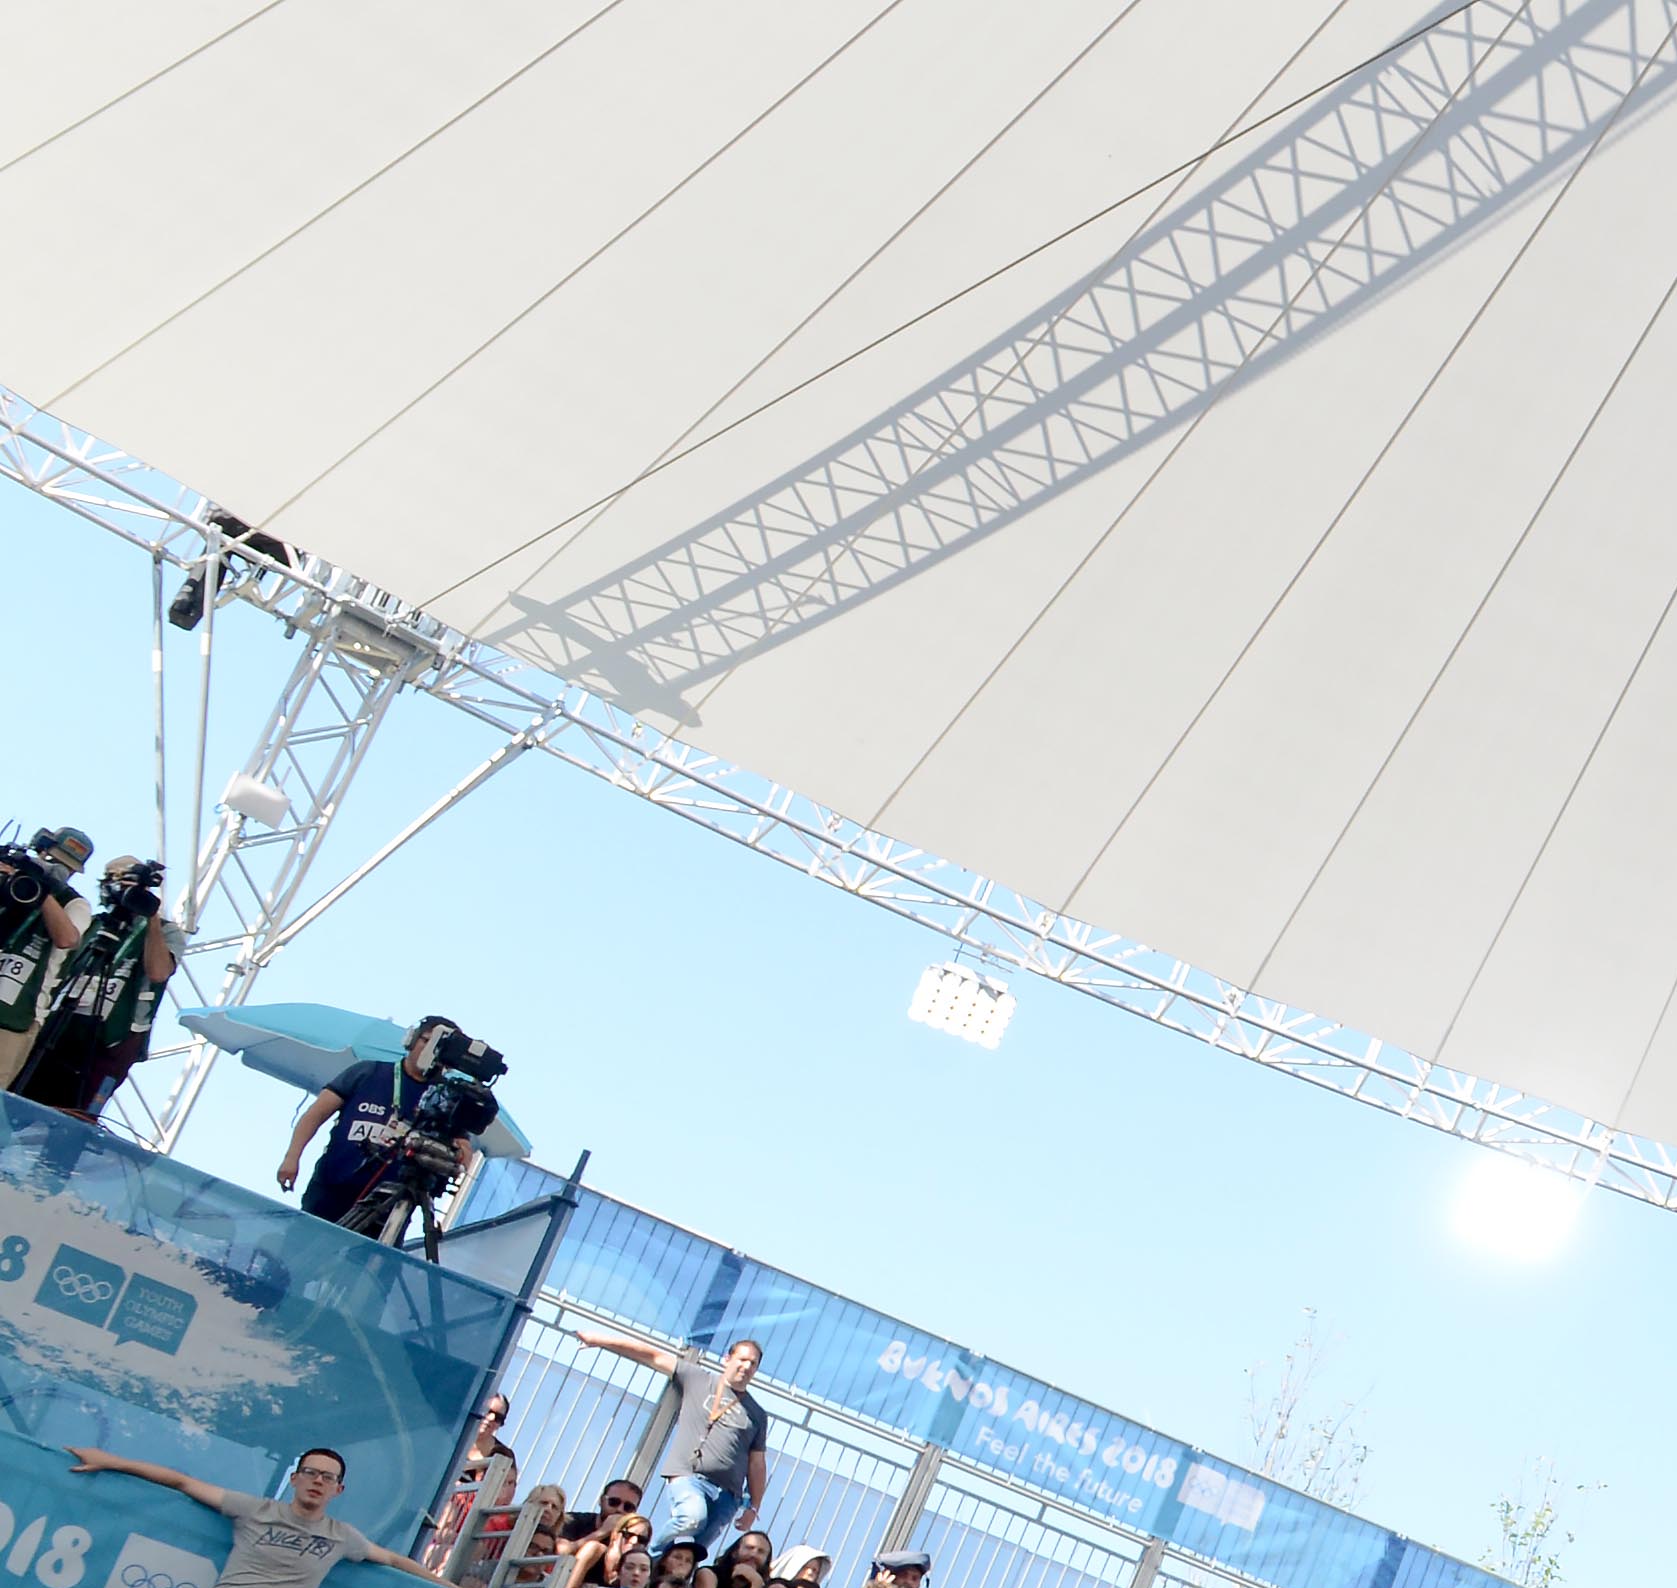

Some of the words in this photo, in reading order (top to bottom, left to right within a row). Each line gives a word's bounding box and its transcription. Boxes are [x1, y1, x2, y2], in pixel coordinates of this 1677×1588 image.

[358, 1102, 386, 1116] OBS
[877, 1340, 1009, 1417] BUENOS
[1012, 1400, 1101, 1456] AIRES
[1102, 1436, 1179, 1489] 2018
[975, 1426, 1030, 1463] Feel
[1033, 1452, 1072, 1484] the
[1074, 1468, 1144, 1514] future
